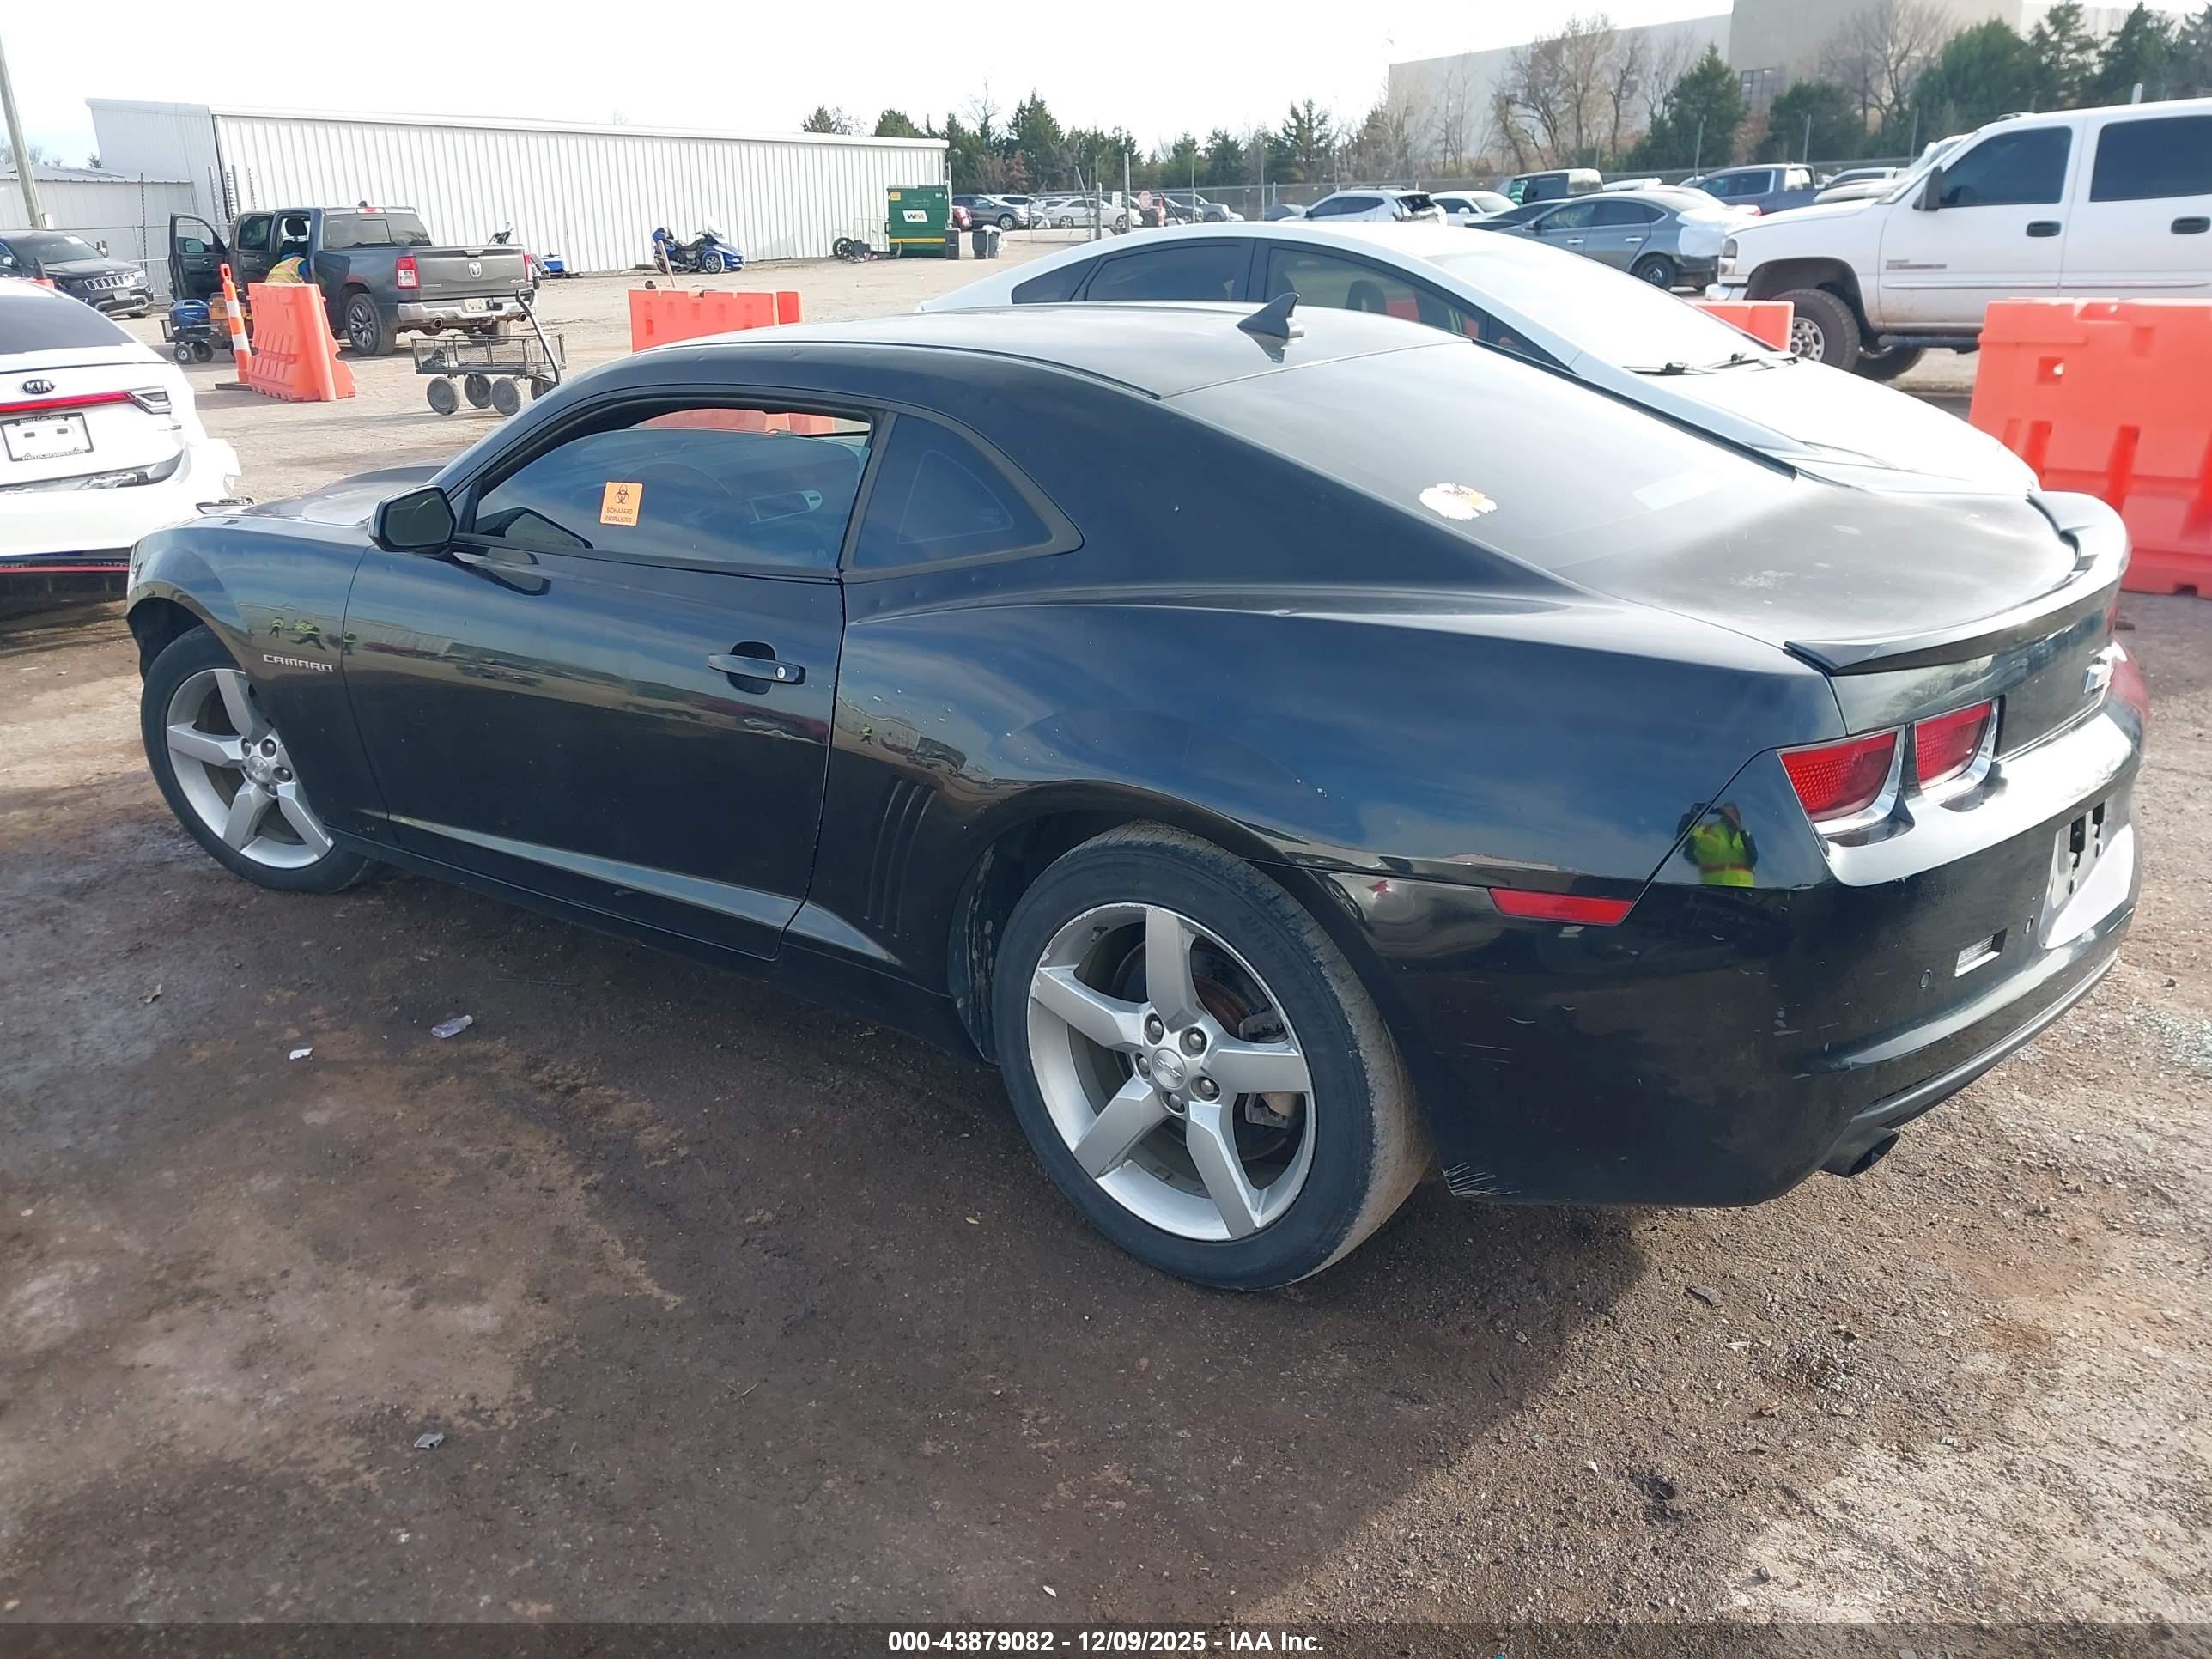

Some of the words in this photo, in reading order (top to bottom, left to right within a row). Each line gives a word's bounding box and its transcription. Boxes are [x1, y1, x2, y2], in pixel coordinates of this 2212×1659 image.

[25, 381, 54, 392] KIA
[606, 507, 633, 515] BIOHAZARD
[263, 653, 334, 672] CAMARO
